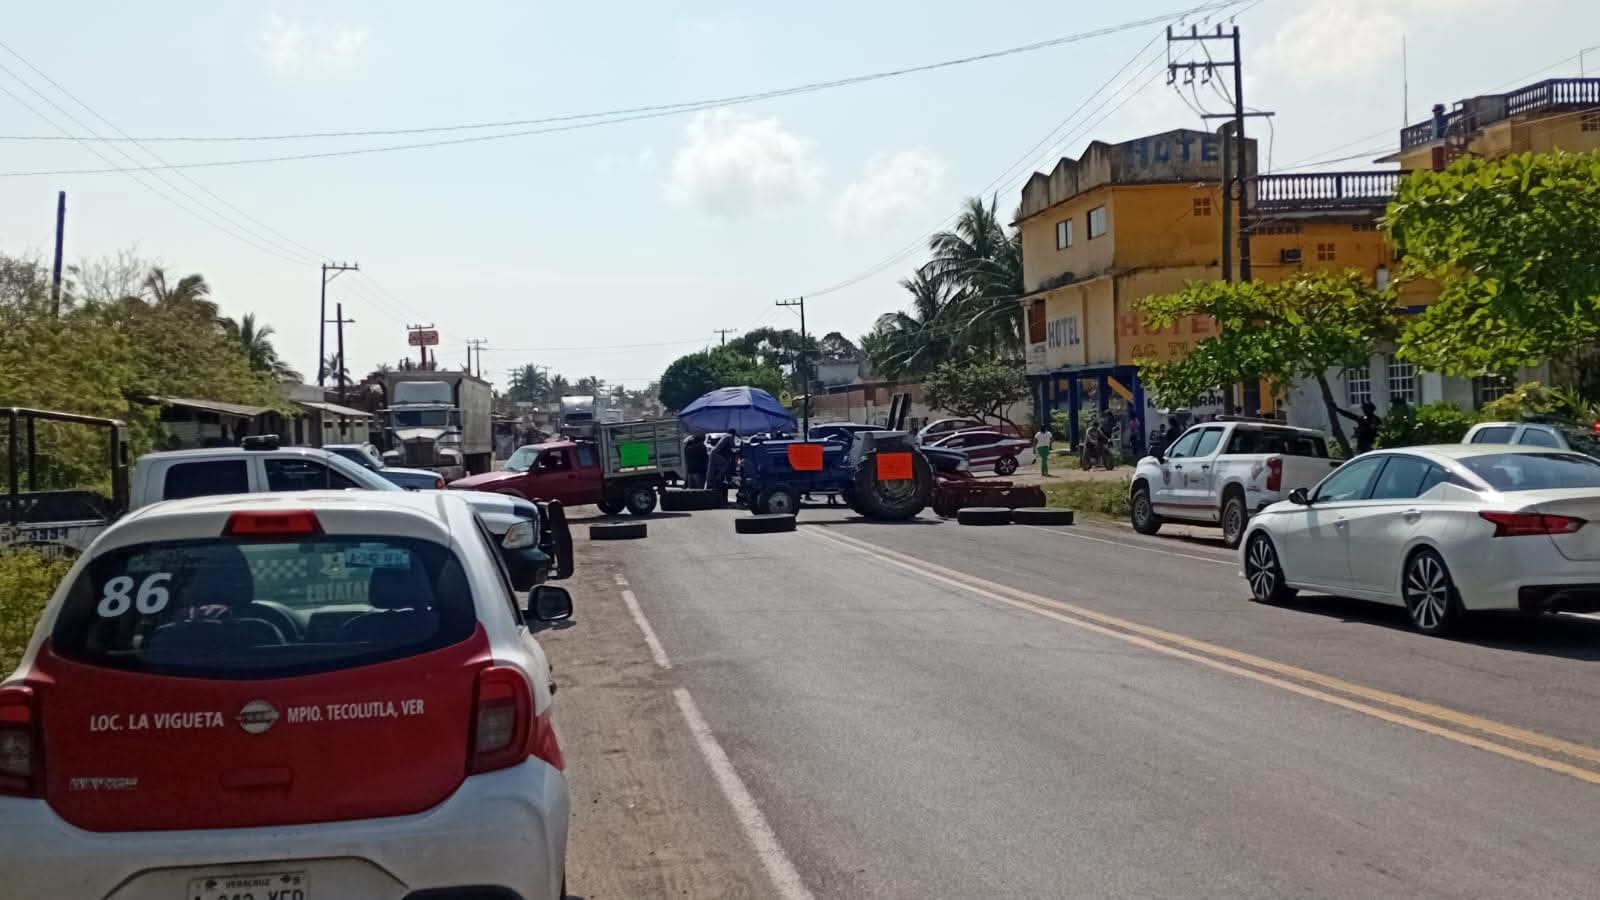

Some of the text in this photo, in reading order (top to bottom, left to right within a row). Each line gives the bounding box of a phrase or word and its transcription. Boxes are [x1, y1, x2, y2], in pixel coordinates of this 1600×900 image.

[1126, 134, 1220, 162] HOTE
[1048, 317, 1080, 348] HOTEL
[1119, 313, 1210, 337] HOTE
[97, 572, 172, 617] 86
[90, 714, 124, 731] LOC.
[128, 713, 149, 730] LA
[153, 711, 224, 729] VIGUETA
[287, 706, 323, 723] MPIO.
[326, 701, 399, 721] TECOLUTLA,
[401, 699, 425, 715] VER
